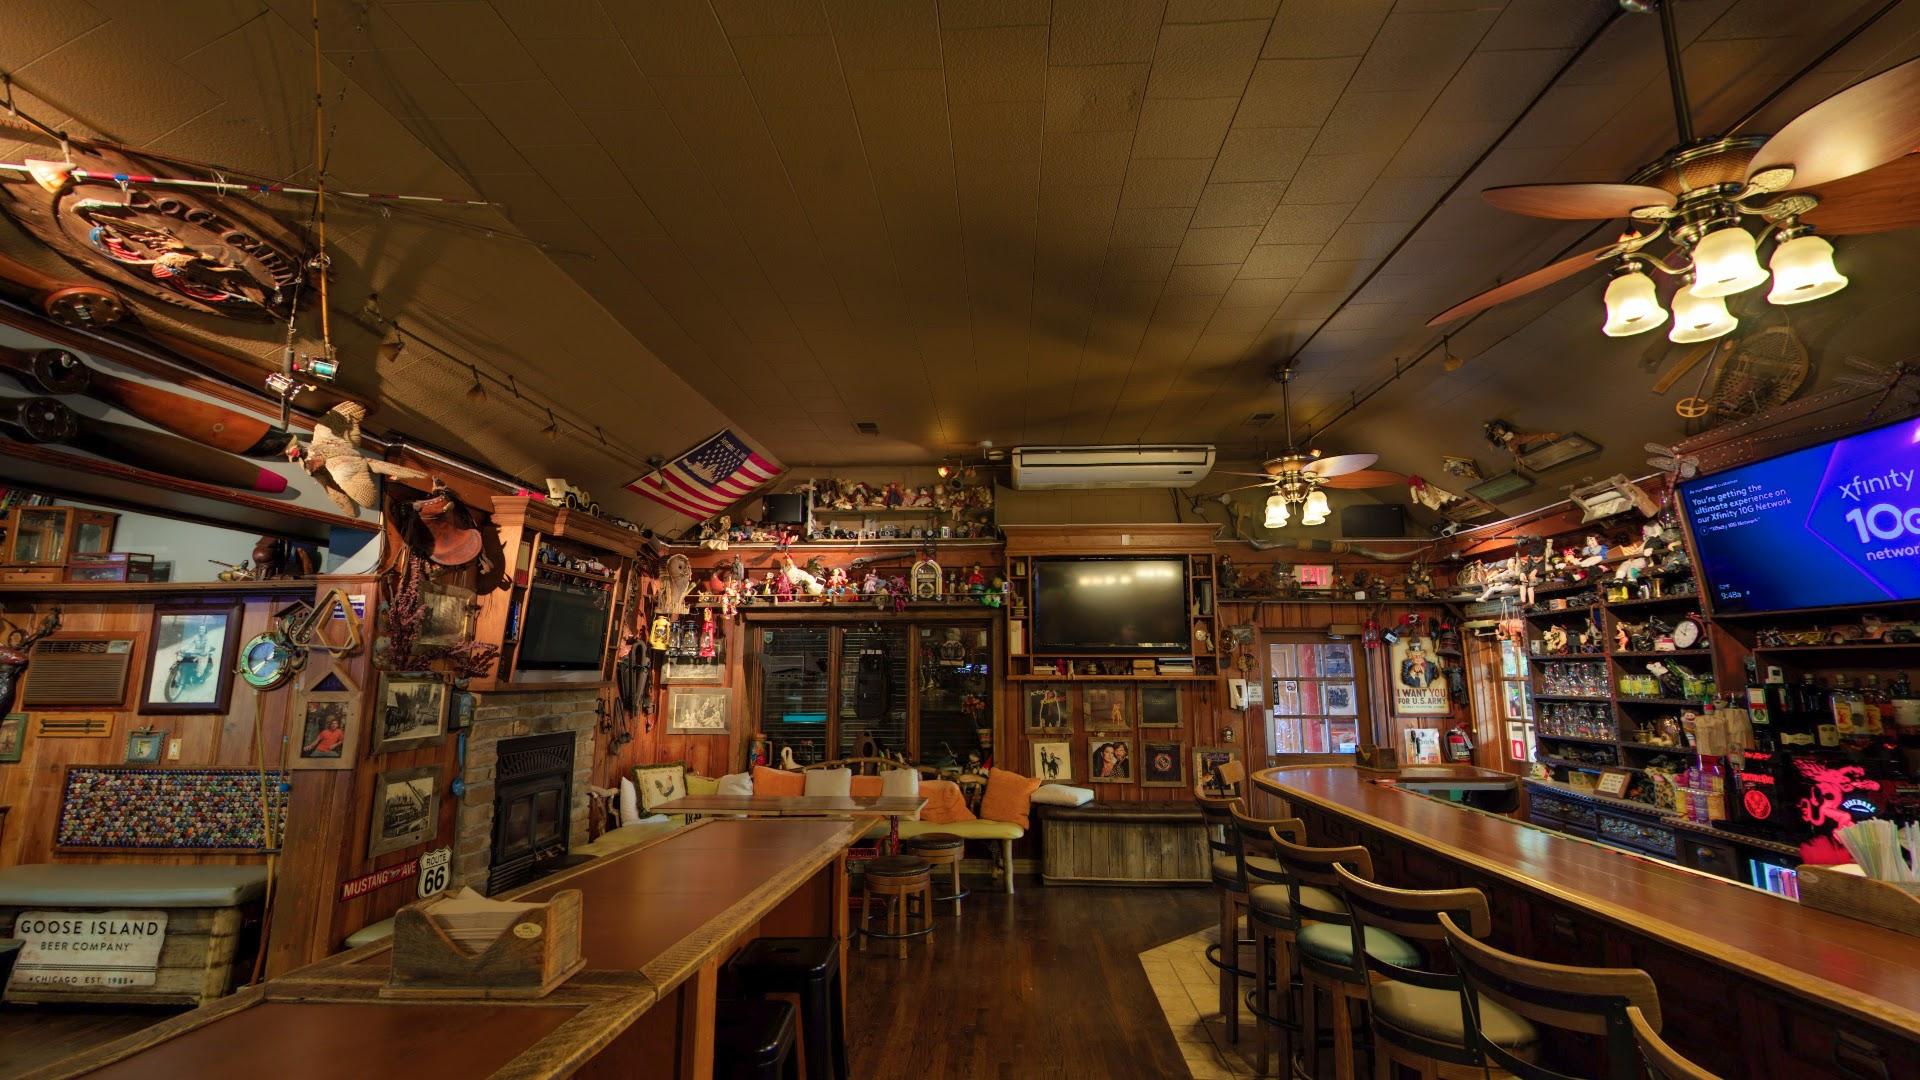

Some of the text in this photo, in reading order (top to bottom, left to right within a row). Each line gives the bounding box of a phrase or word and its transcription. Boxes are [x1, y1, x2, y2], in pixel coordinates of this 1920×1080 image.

[1838, 468, 1914, 502] xfinity
[1692, 484, 1762, 506] You're getting the
[1695, 488, 1786, 515] ultimate experience on
[1697, 497, 1792, 524] our Xfinity 10G Network
[1866, 544, 1920, 561] networ
[1301, 566, 1329, 586] EXIT
[1398, 697, 1410, 705] FOR
[1427, 697, 1447, 705] ARMY
[1402, 688, 1427, 698] WANT
[1428, 688, 1446, 698] YOU
[426, 853, 447, 866] ROUTE
[343, 860, 417, 898] MUSTANG AVE
[424, 865, 446, 895] 66
[21, 920, 159, 936] GOOSE ISLAND
[40, 941, 130, 952] BEER COMPANY
[34, 975, 78, 984] CHICAGO
